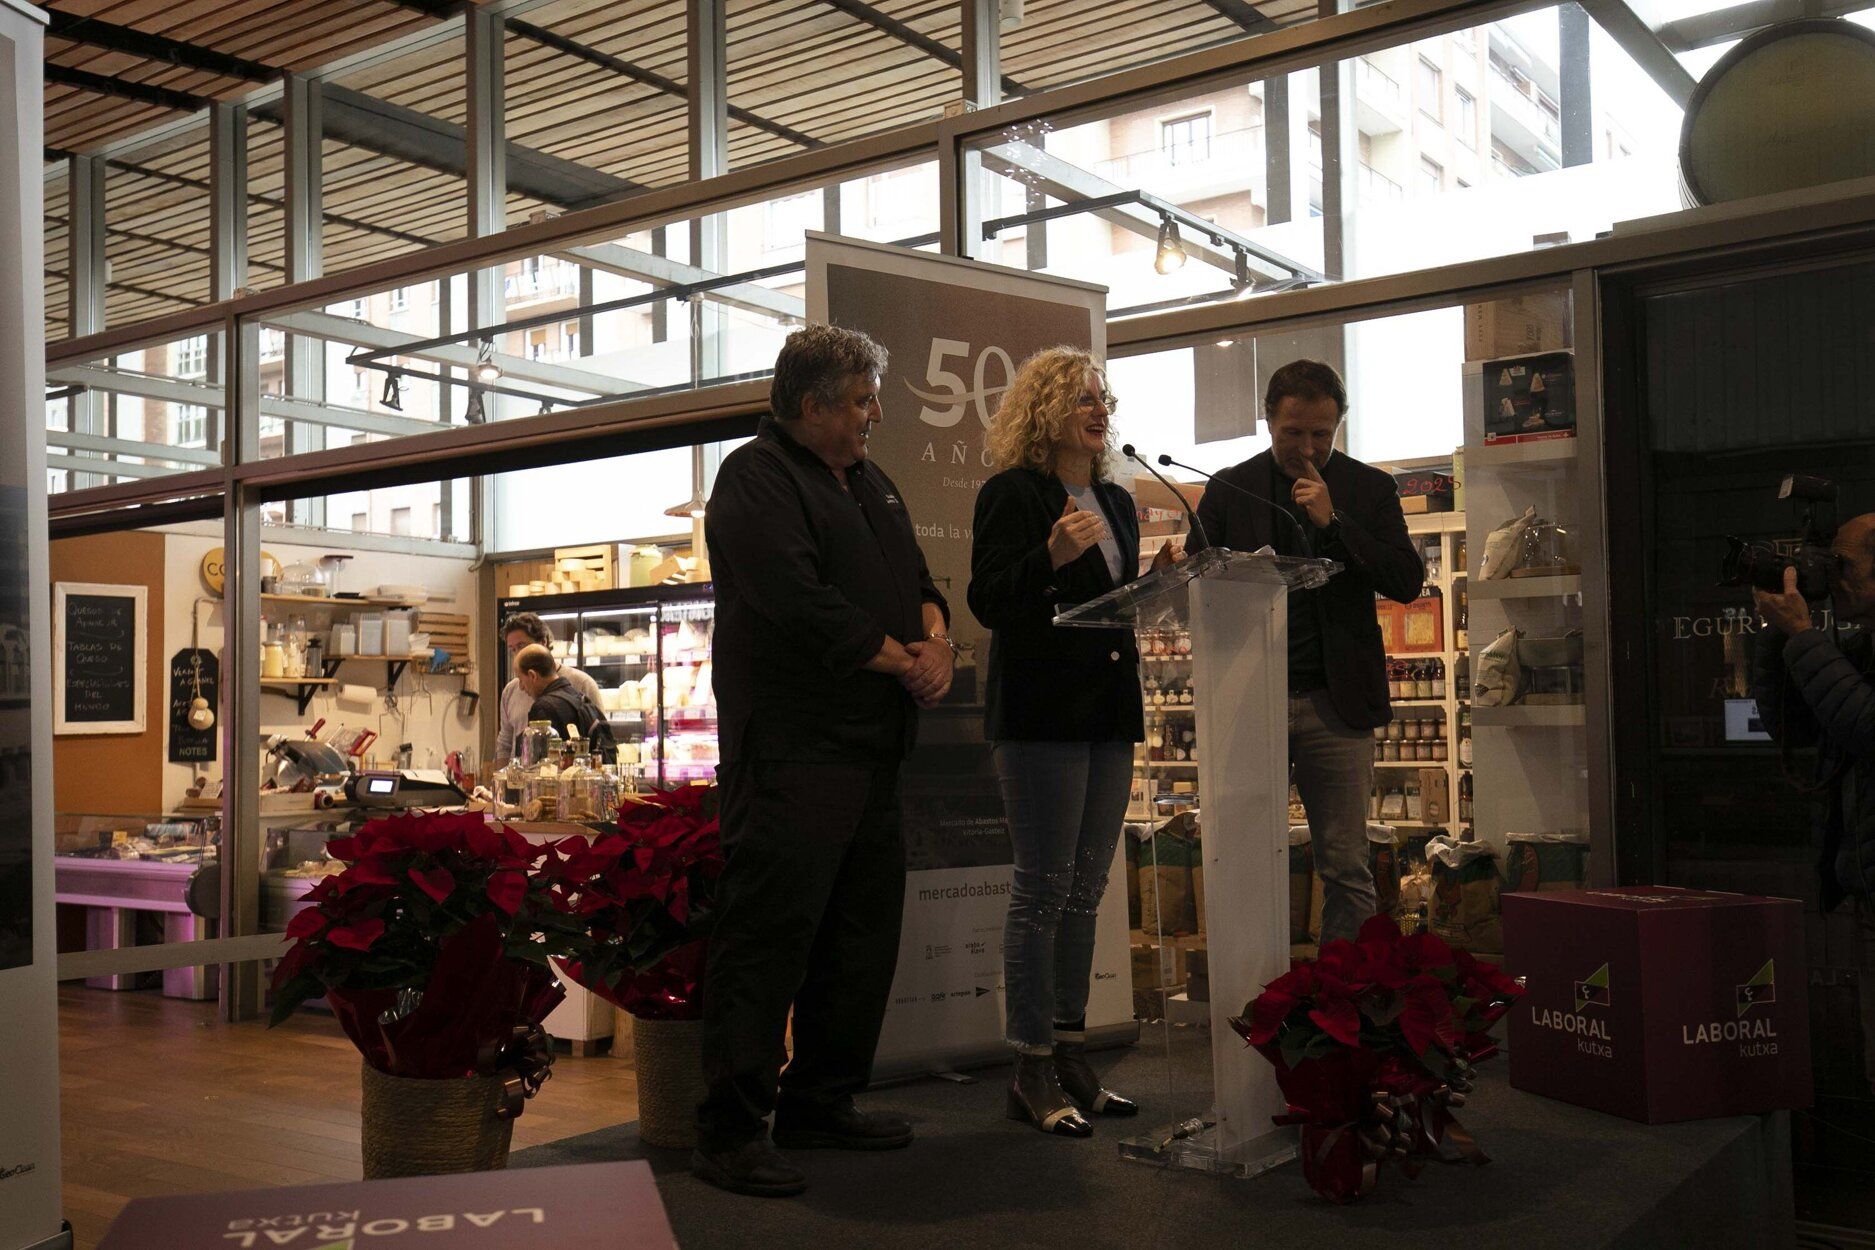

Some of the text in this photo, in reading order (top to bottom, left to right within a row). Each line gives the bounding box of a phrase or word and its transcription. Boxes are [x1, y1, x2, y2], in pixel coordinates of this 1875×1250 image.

[921, 440, 995, 467] AÑO
[943, 477, 968, 489] Desde
[915, 523, 945, 538] toda
[949, 523, 961, 539] la
[1673, 614, 1767, 639] EGUR
[919, 881, 1011, 900] mercadoabast
[1532, 1006, 1611, 1041] LABORAL
[1682, 1018, 1777, 1045] LABORAL
[1578, 1038, 1613, 1058] kutxa
[1740, 1041, 1778, 1057] kutxa
[223, 1207, 545, 1247] LABORAL
